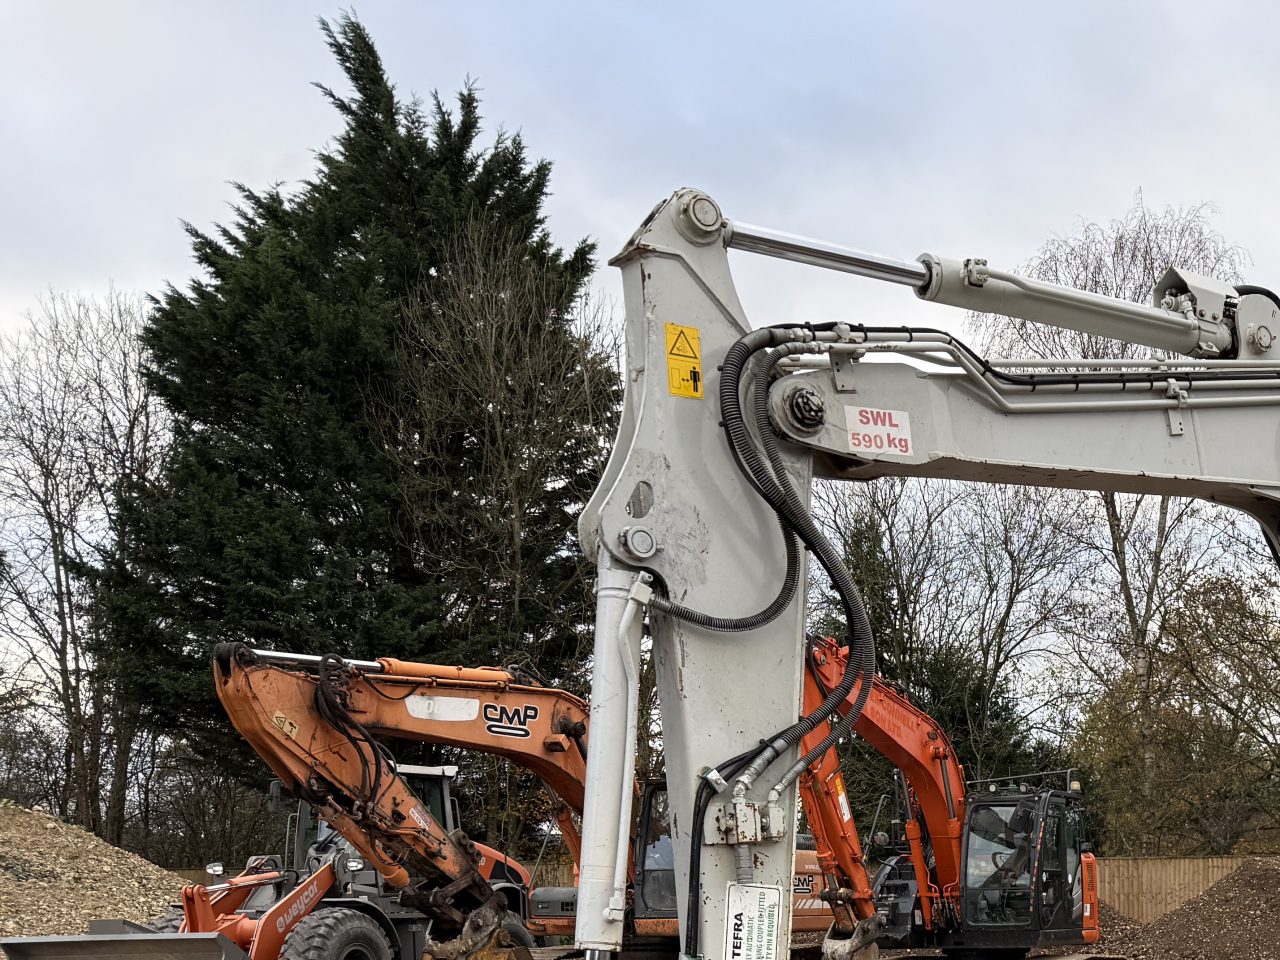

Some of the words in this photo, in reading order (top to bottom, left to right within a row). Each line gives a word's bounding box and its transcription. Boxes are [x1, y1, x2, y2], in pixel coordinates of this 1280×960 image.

[858, 409, 899, 428] SWL
[851, 432, 884, 449] 590
[886, 432, 909, 453] kg
[483, 703, 539, 727] CMP
[283, 879, 319, 925] weycor
[758, 891, 766, 913] FITTED
[746, 916, 754, 952] AUTOMATIC
[767, 904, 776, 937] REQUIRED
[732, 912, 744, 959] TEFRA
